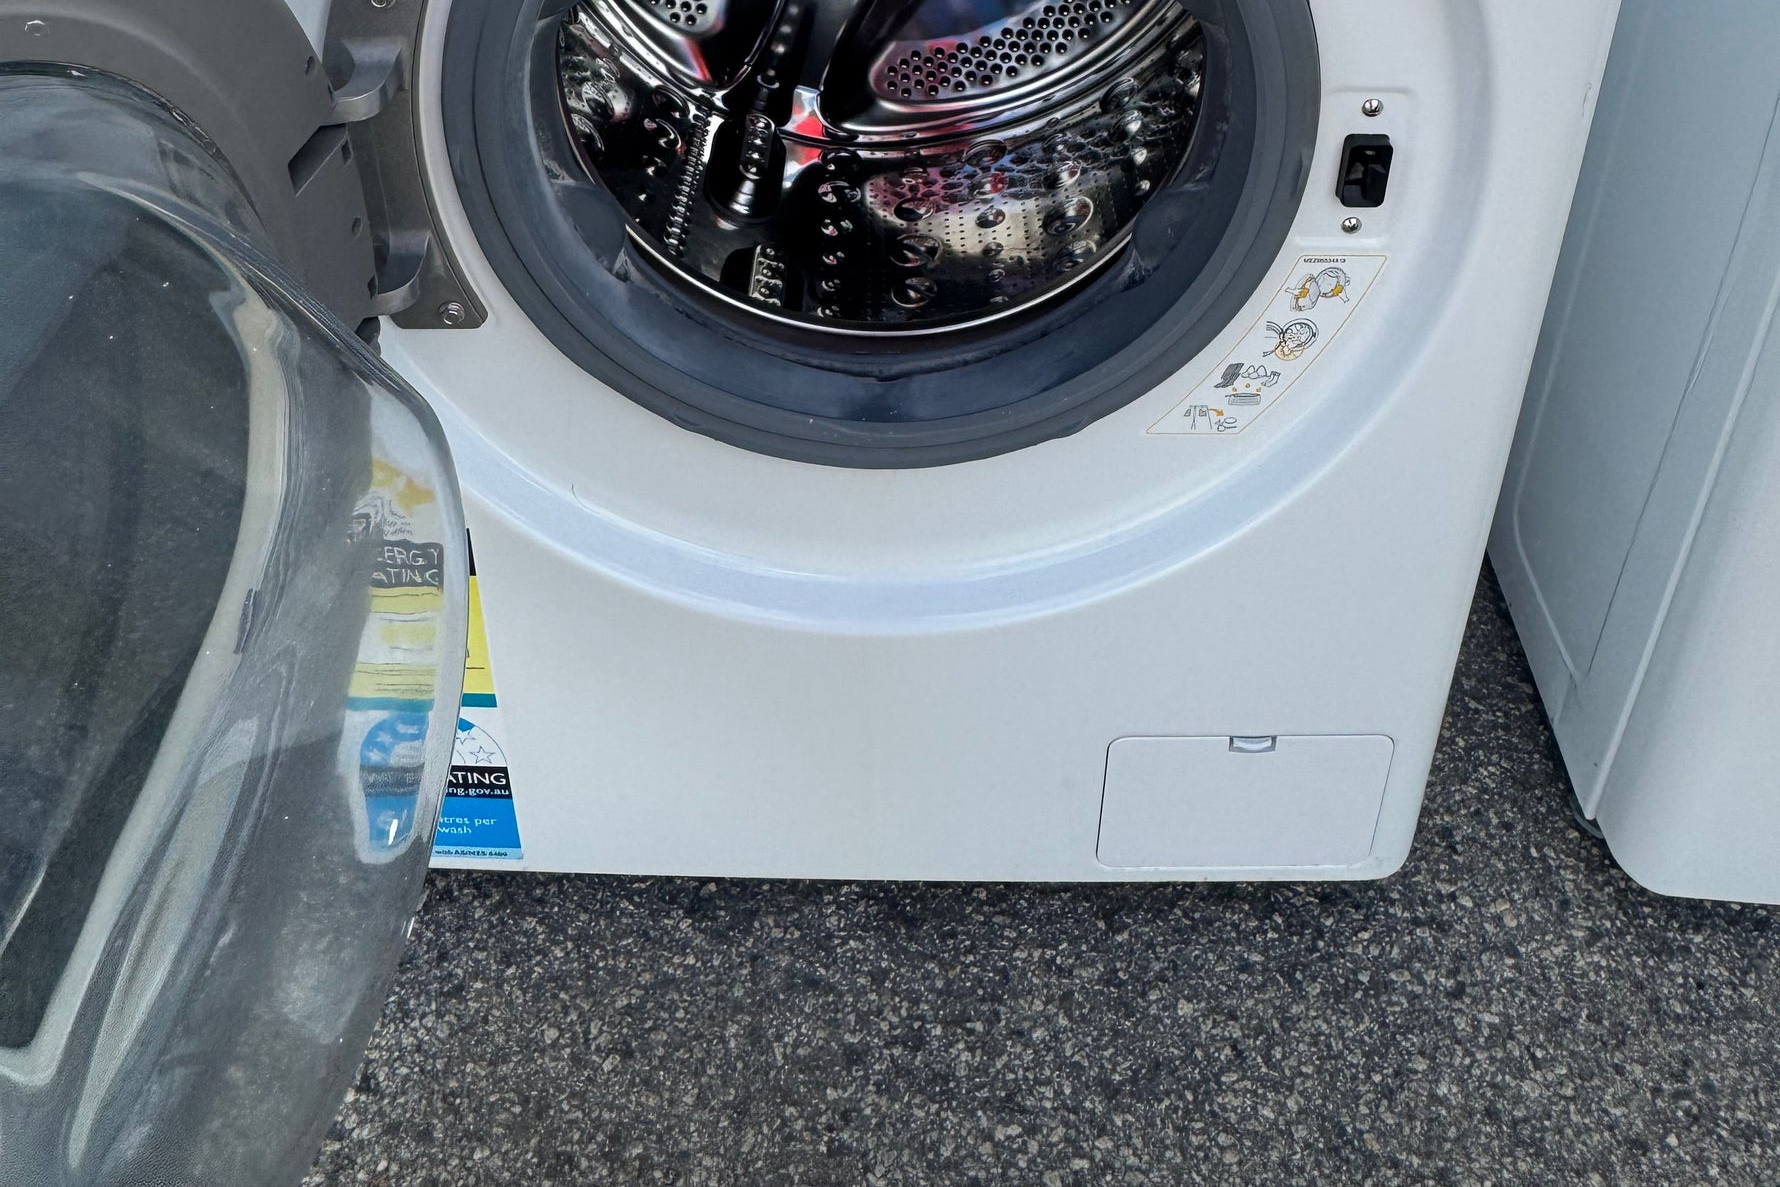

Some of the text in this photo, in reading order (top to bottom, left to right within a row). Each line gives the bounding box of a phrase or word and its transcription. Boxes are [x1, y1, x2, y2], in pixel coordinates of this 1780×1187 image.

[448, 771, 507, 785] ATING
[474, 817, 497, 827] per
[438, 826, 472, 834] wash
